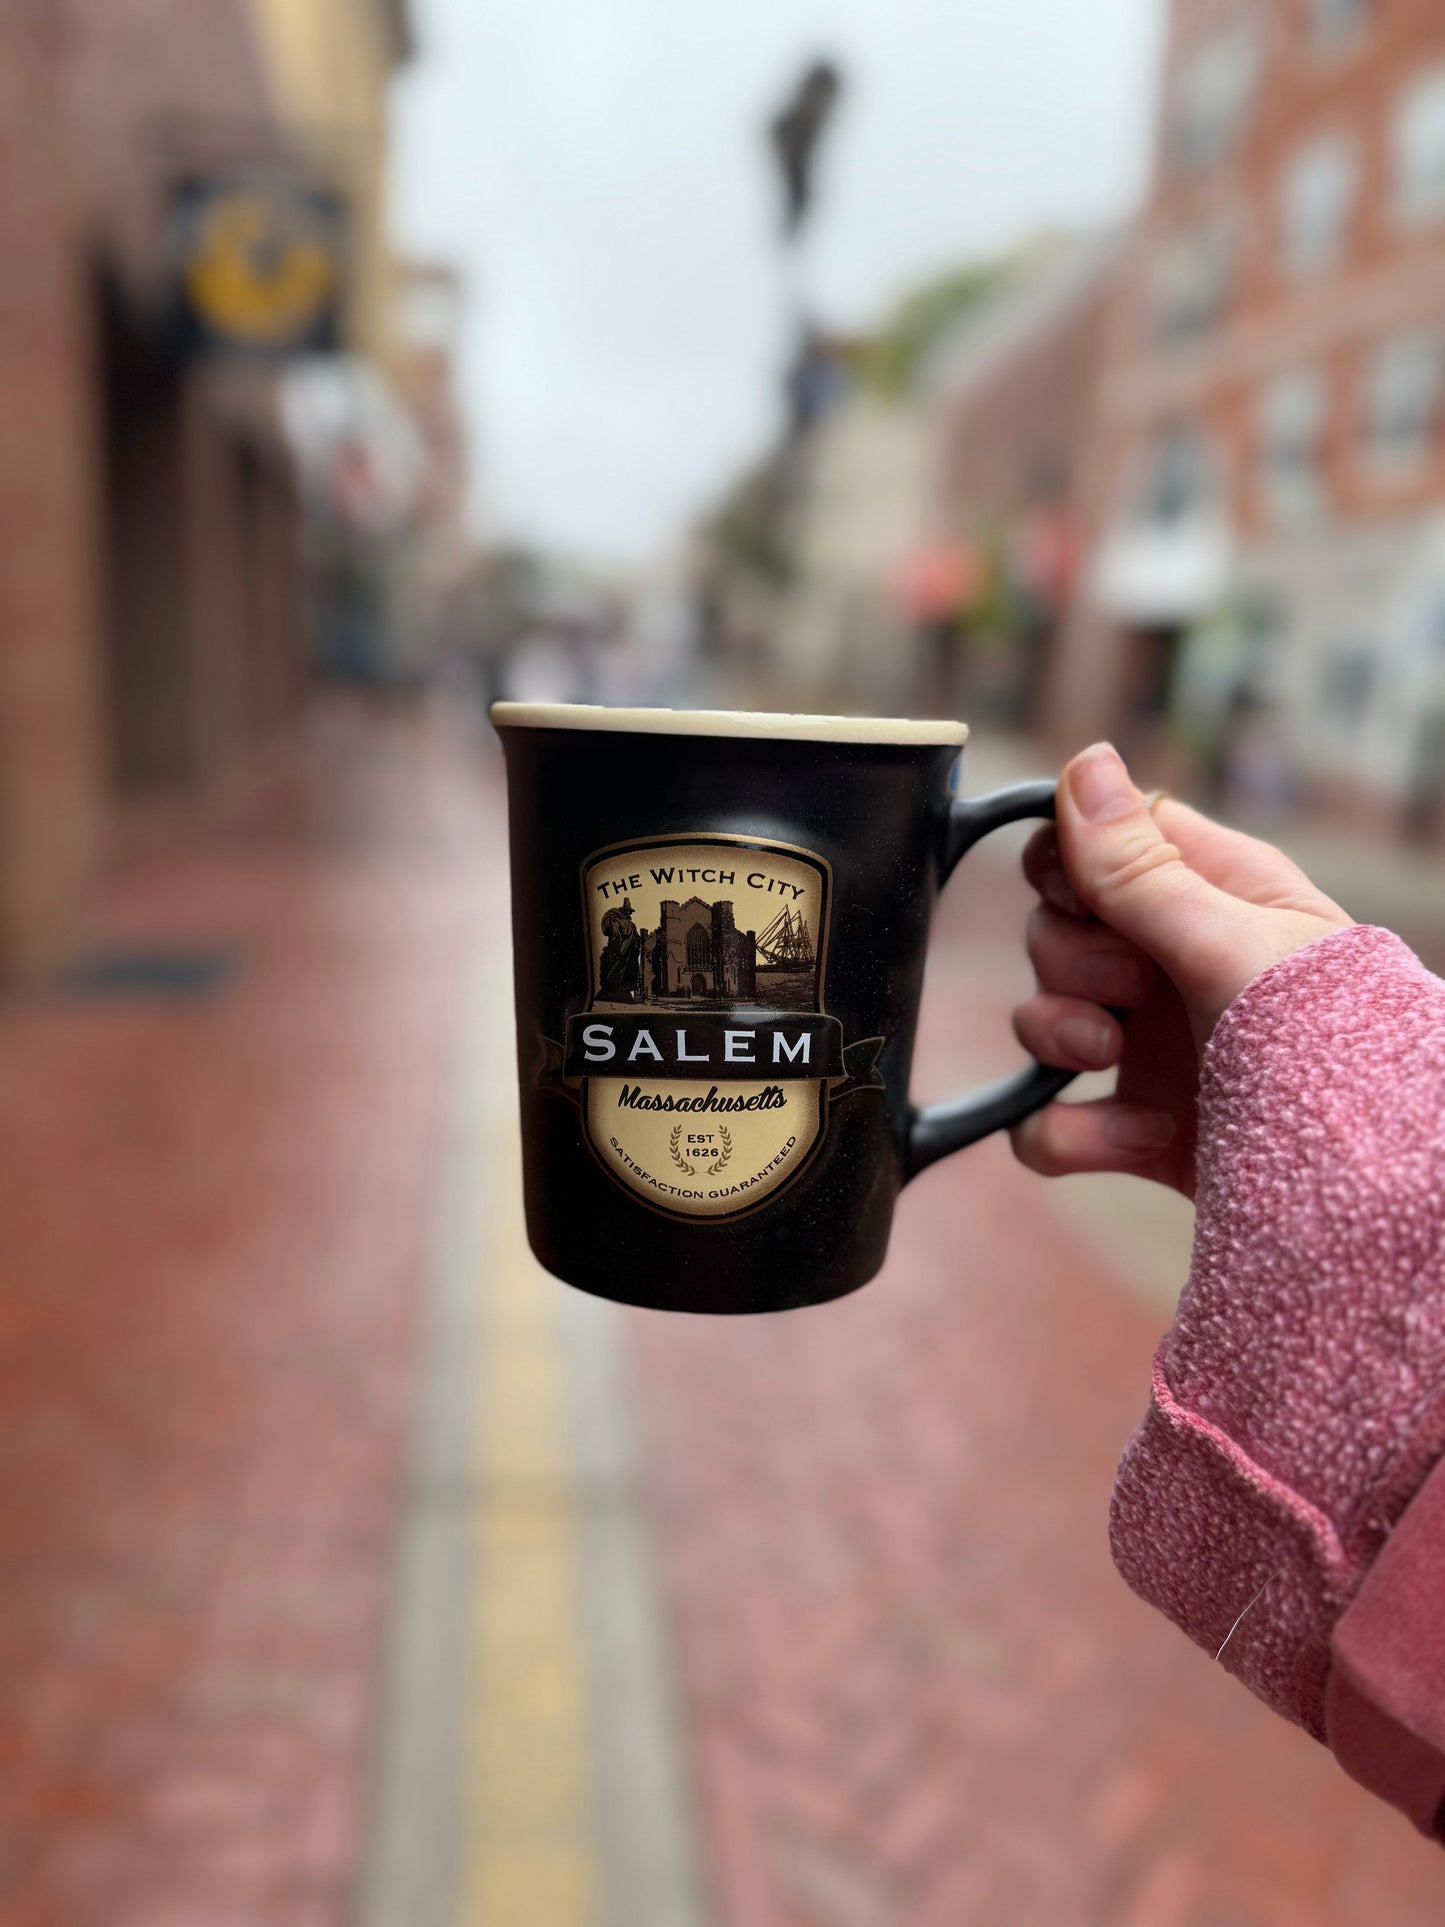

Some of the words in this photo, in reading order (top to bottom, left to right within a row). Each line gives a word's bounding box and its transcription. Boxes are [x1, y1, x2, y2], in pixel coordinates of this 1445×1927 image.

[597, 874, 643, 900] THE
[650, 867, 736, 885] WITCH
[746, 872, 806, 900] CITY
[582, 1024, 812, 1064] SALEM
[617, 1084, 788, 1113] Massachusetts
[685, 1148, 719, 1157] 1626
[687, 1134, 715, 1143] EST
[609, 1136, 704, 1199] SATISFACTION
[708, 1135, 797, 1199] GUARANTEED
